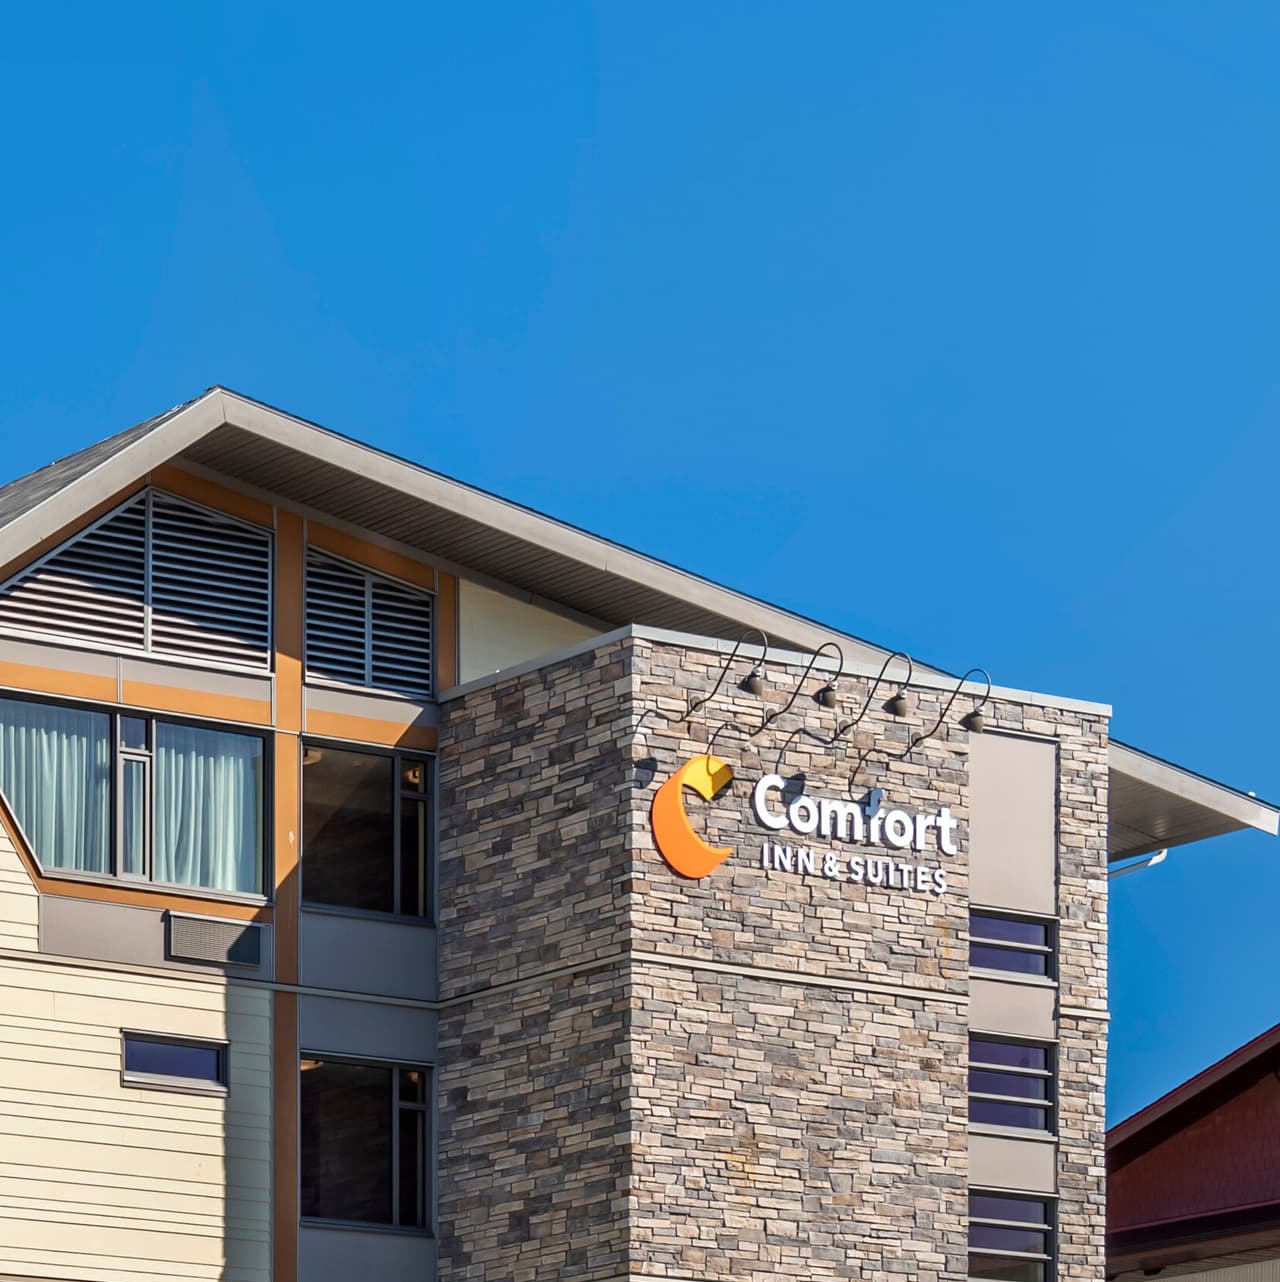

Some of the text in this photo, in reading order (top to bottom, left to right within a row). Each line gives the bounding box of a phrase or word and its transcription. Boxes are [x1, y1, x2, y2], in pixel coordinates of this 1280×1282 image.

[754, 773, 958, 856] Comfort
[762, 843, 947, 894] INN & SUITES
